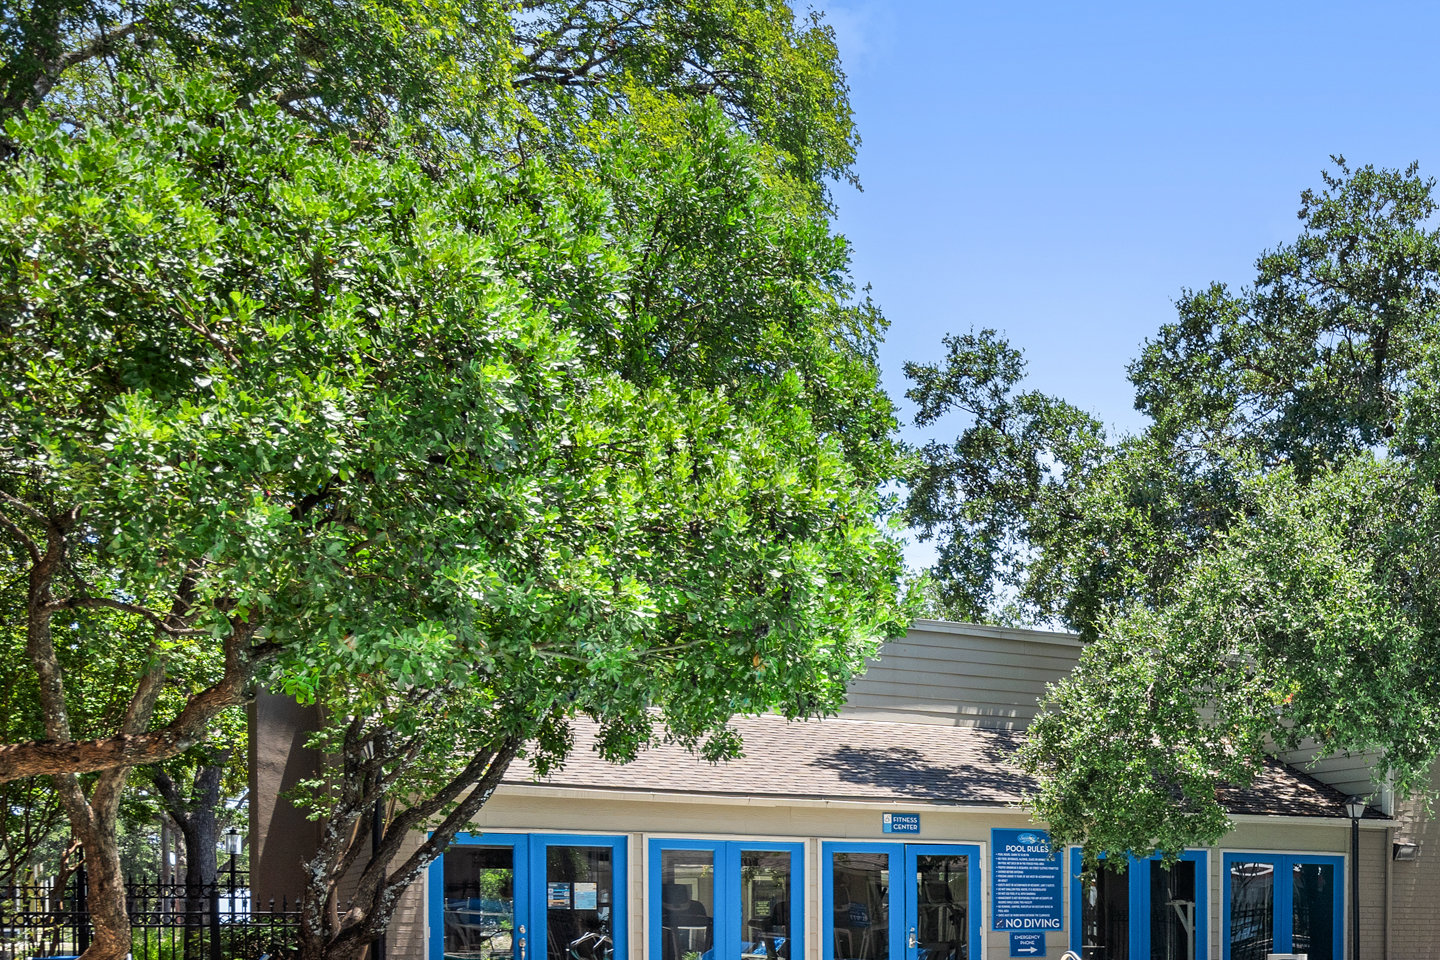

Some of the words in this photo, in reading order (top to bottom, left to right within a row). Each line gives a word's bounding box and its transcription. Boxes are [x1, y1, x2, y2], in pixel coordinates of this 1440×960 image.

[1027, 845, 1049, 853] RULES
[1005, 918, 1022, 928] NO
[1024, 918, 1060, 928] DIVING
